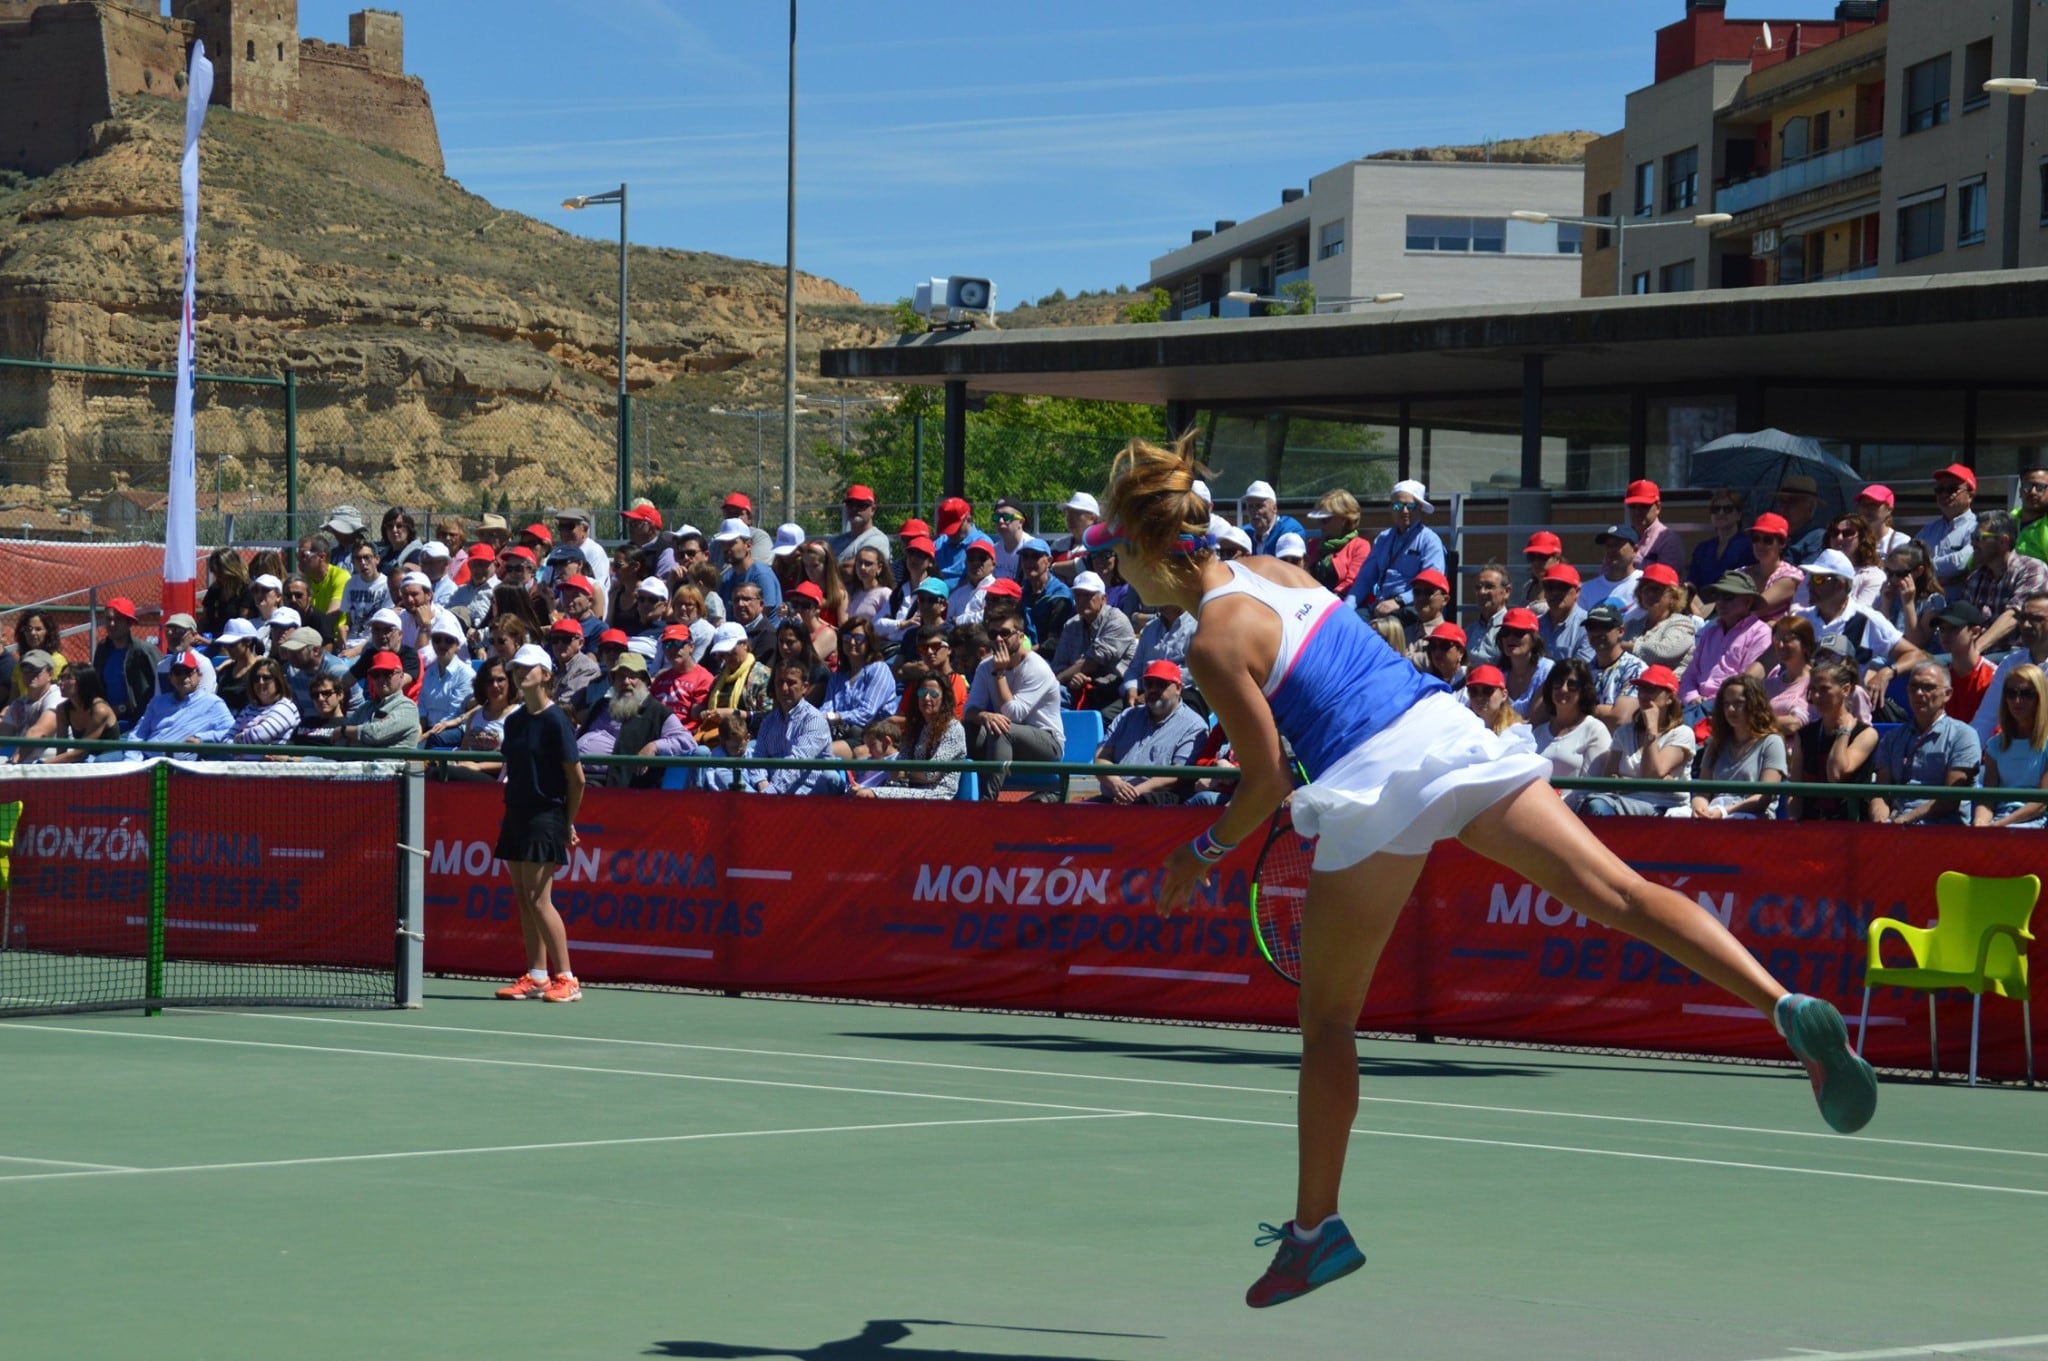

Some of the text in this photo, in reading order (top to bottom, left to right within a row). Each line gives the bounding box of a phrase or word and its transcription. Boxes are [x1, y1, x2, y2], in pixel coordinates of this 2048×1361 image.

[1295, 603, 1312, 621] FILA
[166, 830, 261, 868] CUNA
[37, 864, 80, 899] DE
[608, 849, 718, 889] CUNA
[912, 856, 1111, 905] MONZÓN
[464, 885, 513, 921] DE
[950, 912, 1009, 950] DE
[1539, 936, 1609, 981] DE
